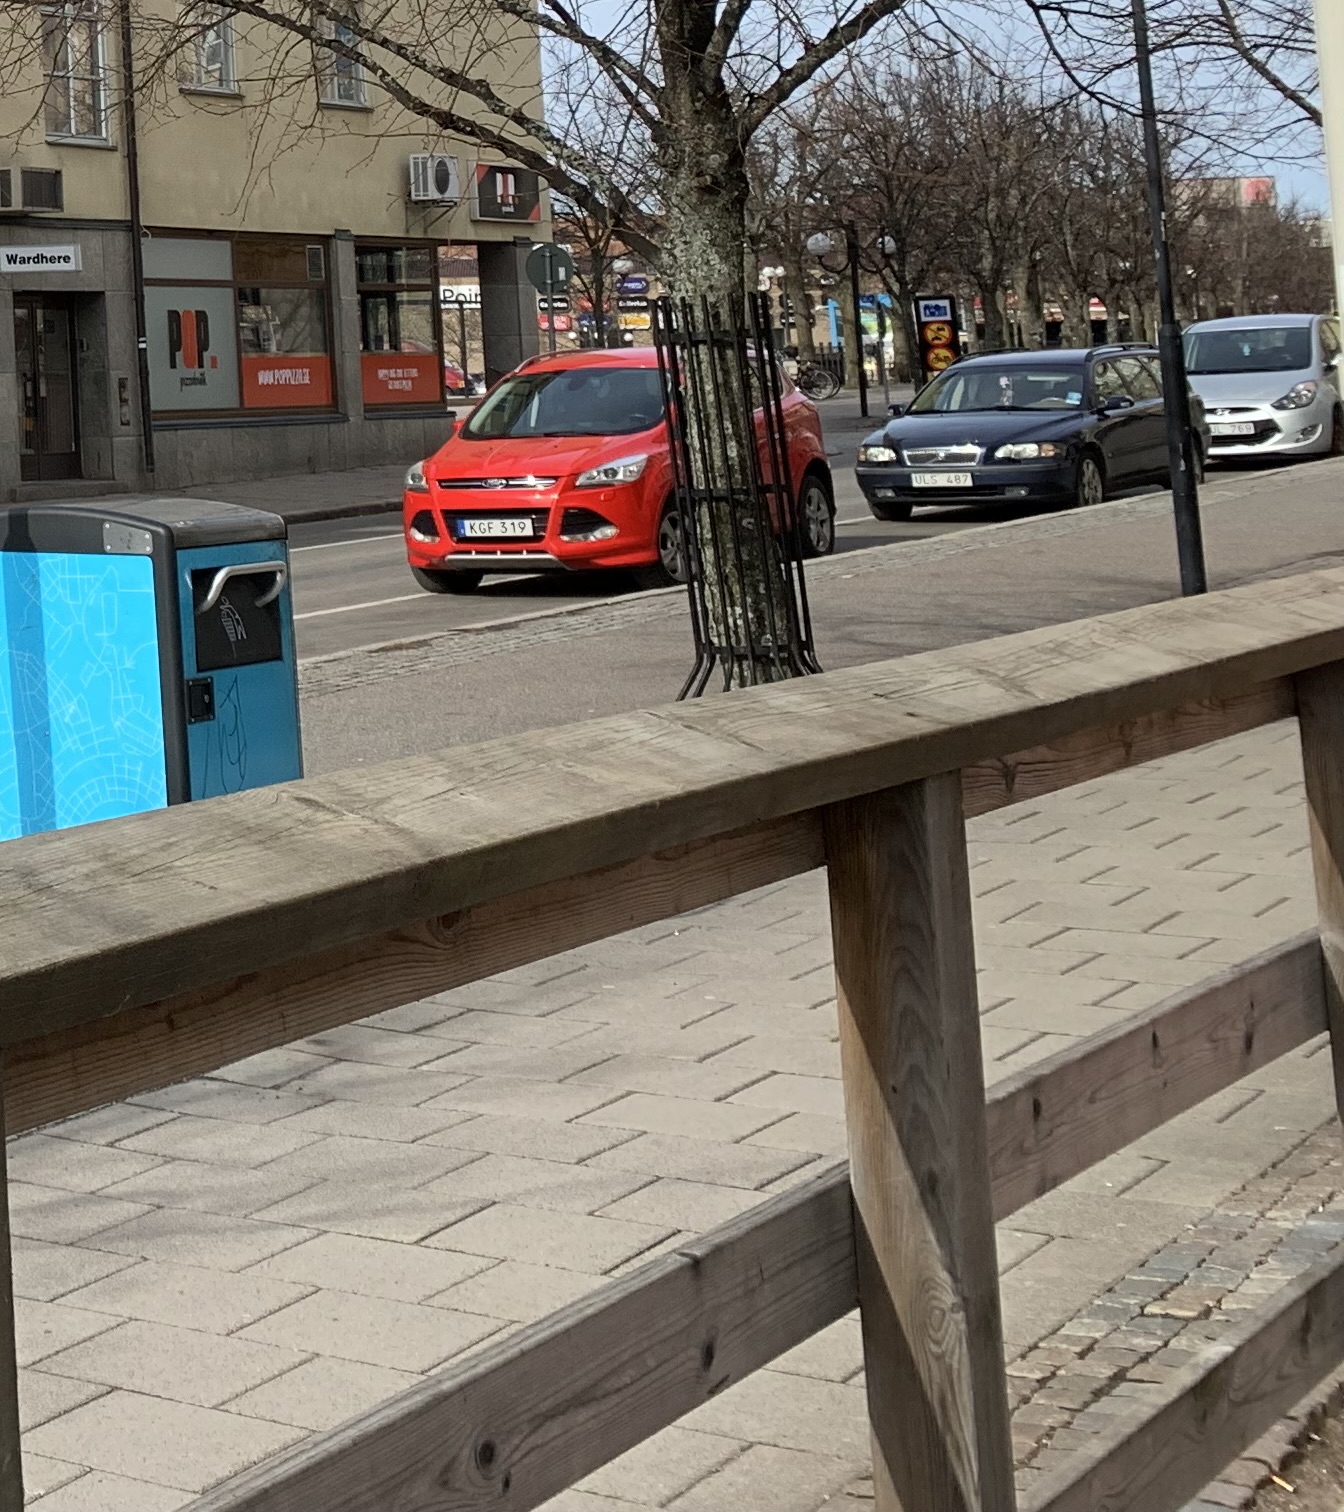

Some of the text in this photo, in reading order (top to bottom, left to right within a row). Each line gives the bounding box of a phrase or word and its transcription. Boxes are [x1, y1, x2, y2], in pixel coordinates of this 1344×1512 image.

[5, 252, 71, 265] Wardhere
[914, 474, 938, 485] ULS
[469, 521, 527, 535] KGF 319
